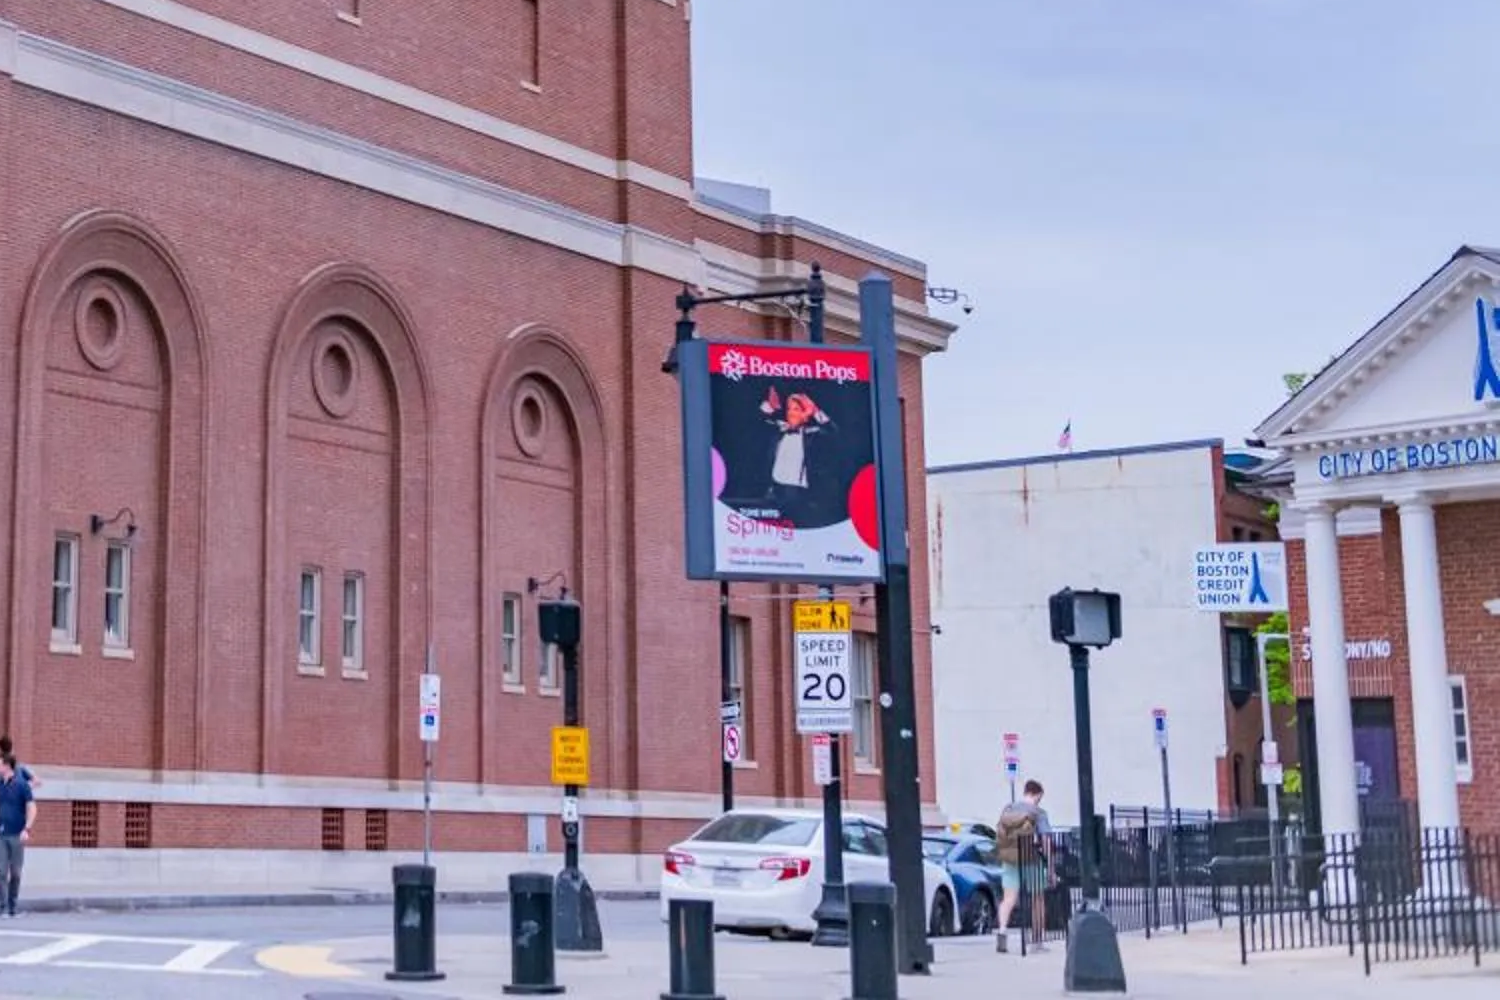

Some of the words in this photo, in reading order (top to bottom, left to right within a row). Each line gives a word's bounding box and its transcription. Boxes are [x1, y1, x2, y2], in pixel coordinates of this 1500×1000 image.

[749, 356, 813, 379] Boston
[815, 359, 857, 385] Pops
[1319, 451, 1363, 478] CITY
[1371, 447, 1397, 473] OF
[1406, 434, 1498, 469] BOSTON
[726, 512, 794, 541] Spring
[1196, 551, 1225, 563] CITY
[1227, 551, 1245, 563] OF
[1197, 565, 1249, 577] BOSTON
[1197, 579, 1245, 591] CREDIT
[1198, 593, 1241, 605] UNION
[801, 639, 846, 653] SPEED
[805, 655, 842, 669] LIMIT
[803, 673, 847, 701] 20
